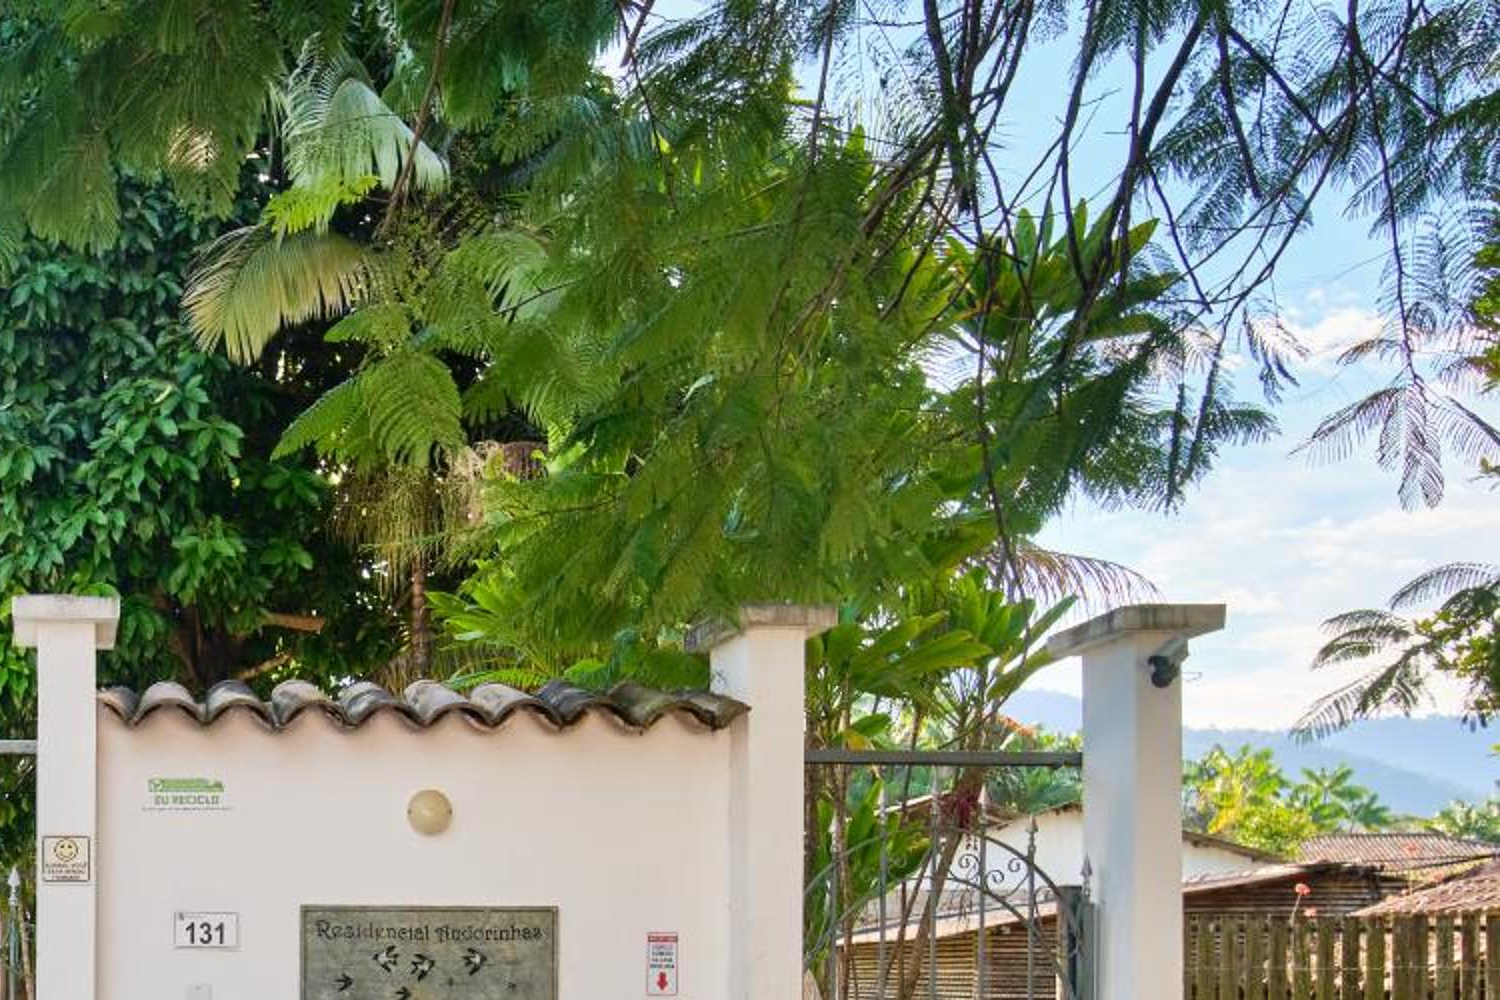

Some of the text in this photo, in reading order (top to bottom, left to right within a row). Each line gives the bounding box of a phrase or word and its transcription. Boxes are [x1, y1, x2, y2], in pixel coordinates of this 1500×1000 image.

[185, 921, 225, 945] 131
[315, 919, 542, 942] Residencial Andorinhas
